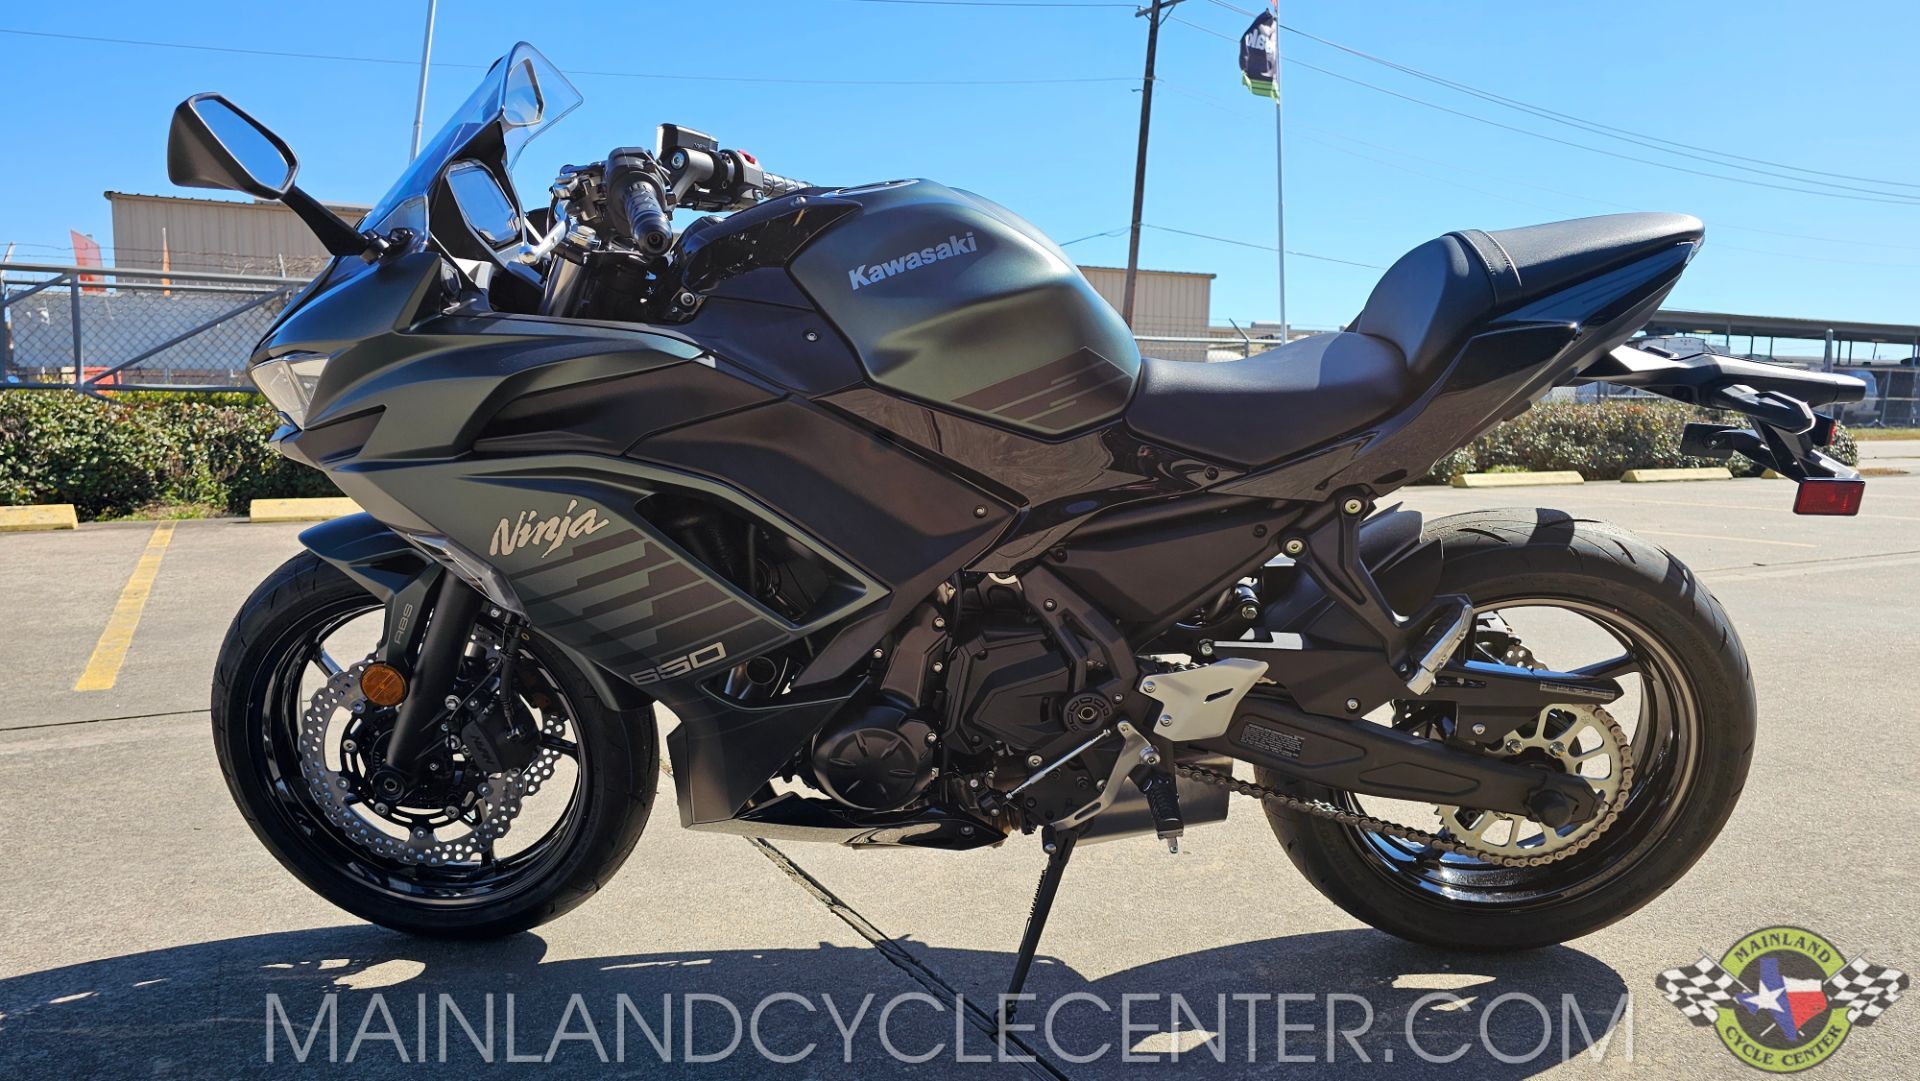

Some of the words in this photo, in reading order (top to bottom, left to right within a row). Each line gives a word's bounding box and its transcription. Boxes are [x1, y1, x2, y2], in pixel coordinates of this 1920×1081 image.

[848, 231, 977, 290] Kawasaki
[489, 499, 610, 558] Ninja
[394, 603, 413, 645] ABS
[629, 641, 727, 685] 650
